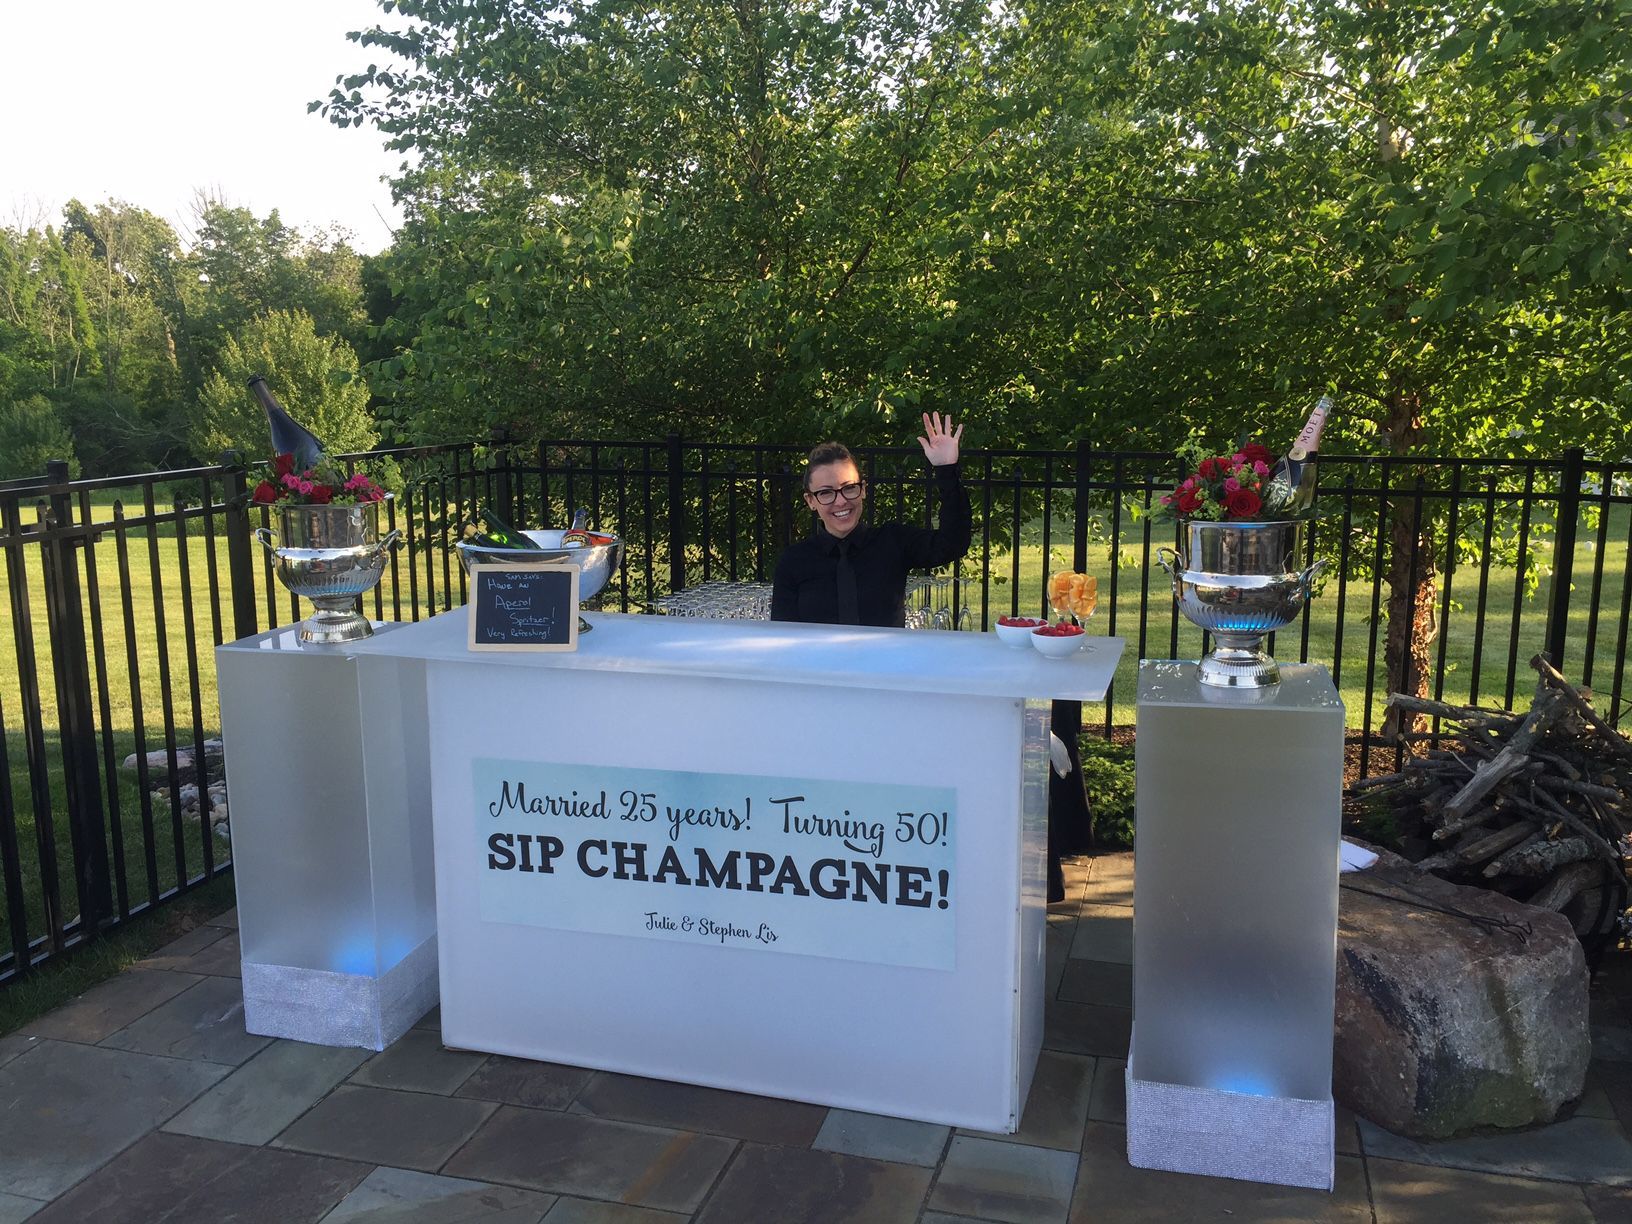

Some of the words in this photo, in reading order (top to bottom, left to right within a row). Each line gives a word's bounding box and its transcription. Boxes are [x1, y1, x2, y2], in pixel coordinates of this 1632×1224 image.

[488, 578, 512, 590] Have
[495, 595, 531, 610] Aperol
[487, 626, 505, 640] Very
[489, 780, 612, 819] Married
[619, 790, 658, 823] 25
[666, 797, 752, 841] years!
[769, 796, 885, 858] Turning
[895, 811, 949, 847] 50!
[487, 832, 565, 875] SIP
[576, 838, 951, 911] CHAMPAGNE!
[644, 912, 678, 932] Julie
[681, 916, 695, 932] &
[698, 917, 752, 943] Stephen
[755, 923, 779, 943] Lis
